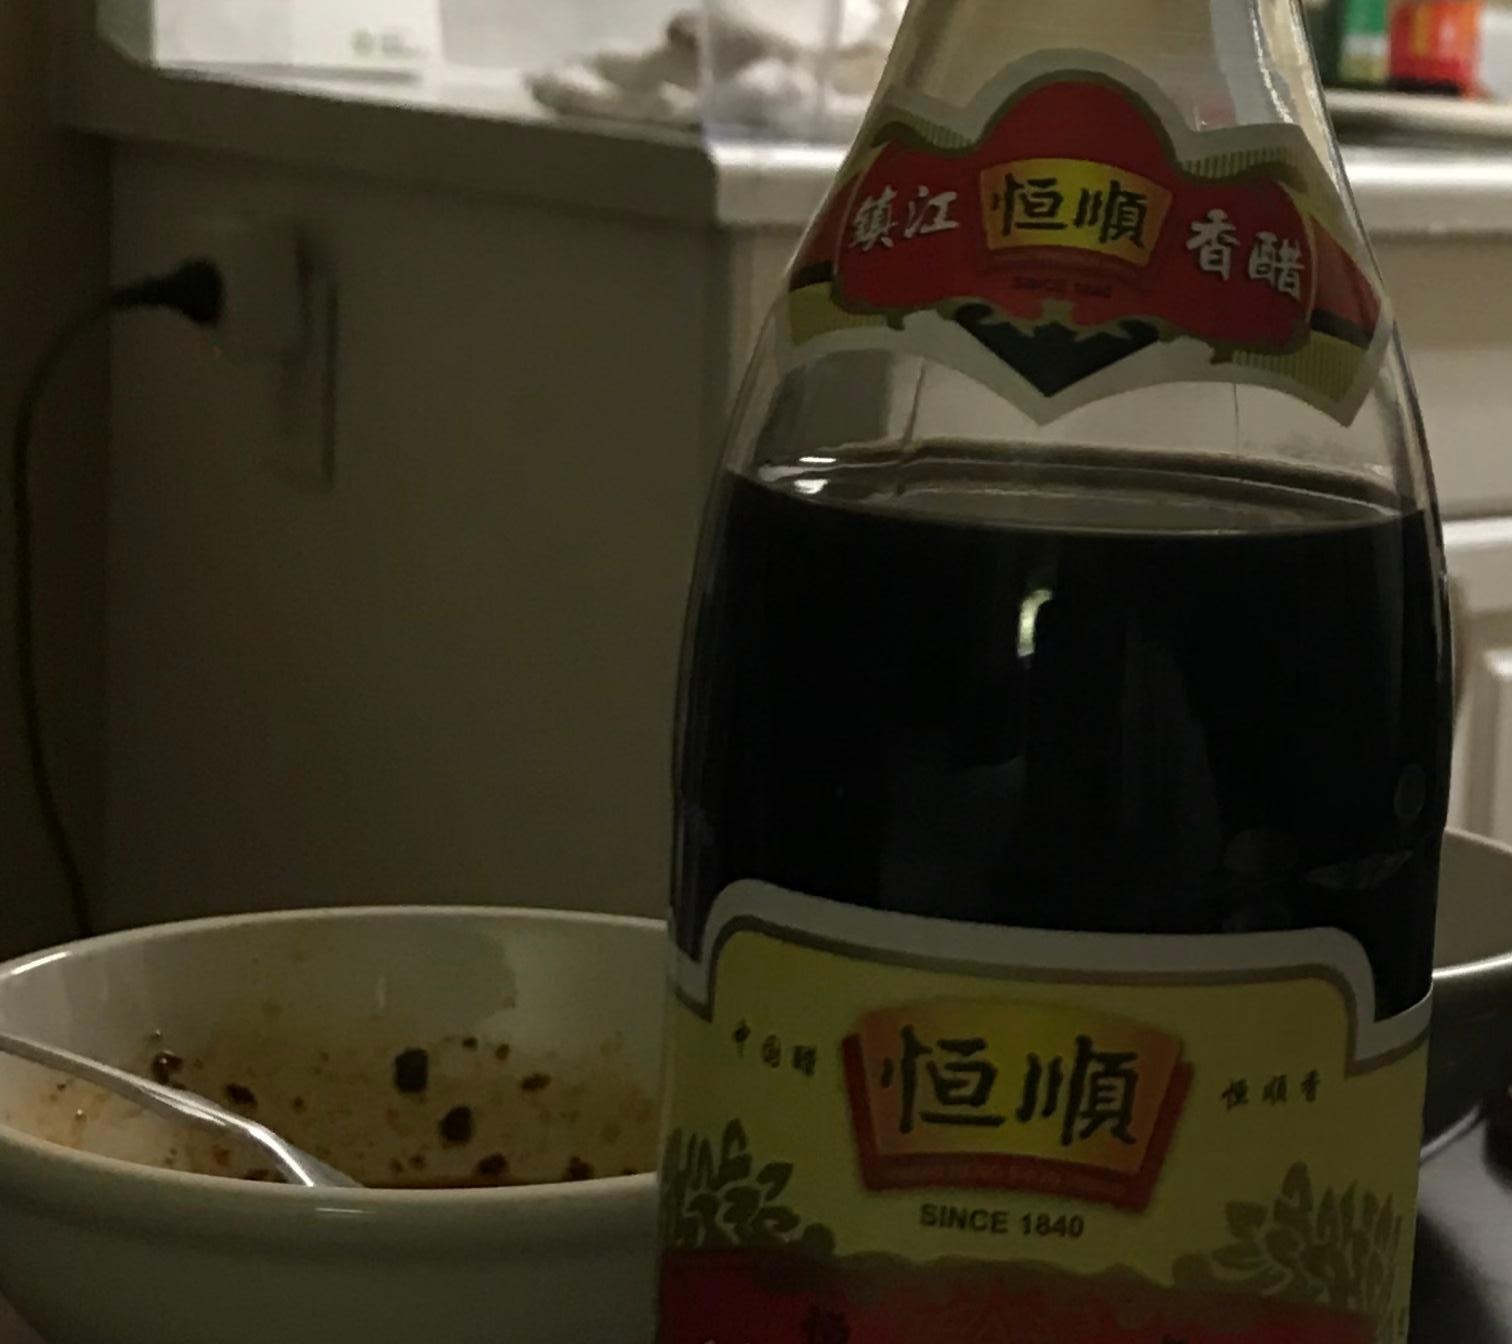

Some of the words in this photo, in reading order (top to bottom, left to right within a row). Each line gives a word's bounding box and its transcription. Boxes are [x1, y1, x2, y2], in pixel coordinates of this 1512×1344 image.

[991, 170, 1151, 249] 恒順
[1186, 208, 1303, 302] 香醋
[880, 1023, 1140, 1146] 恒順
[919, 1202, 1009, 1236] SINCE
[1020, 1211, 1085, 1239] 1840
